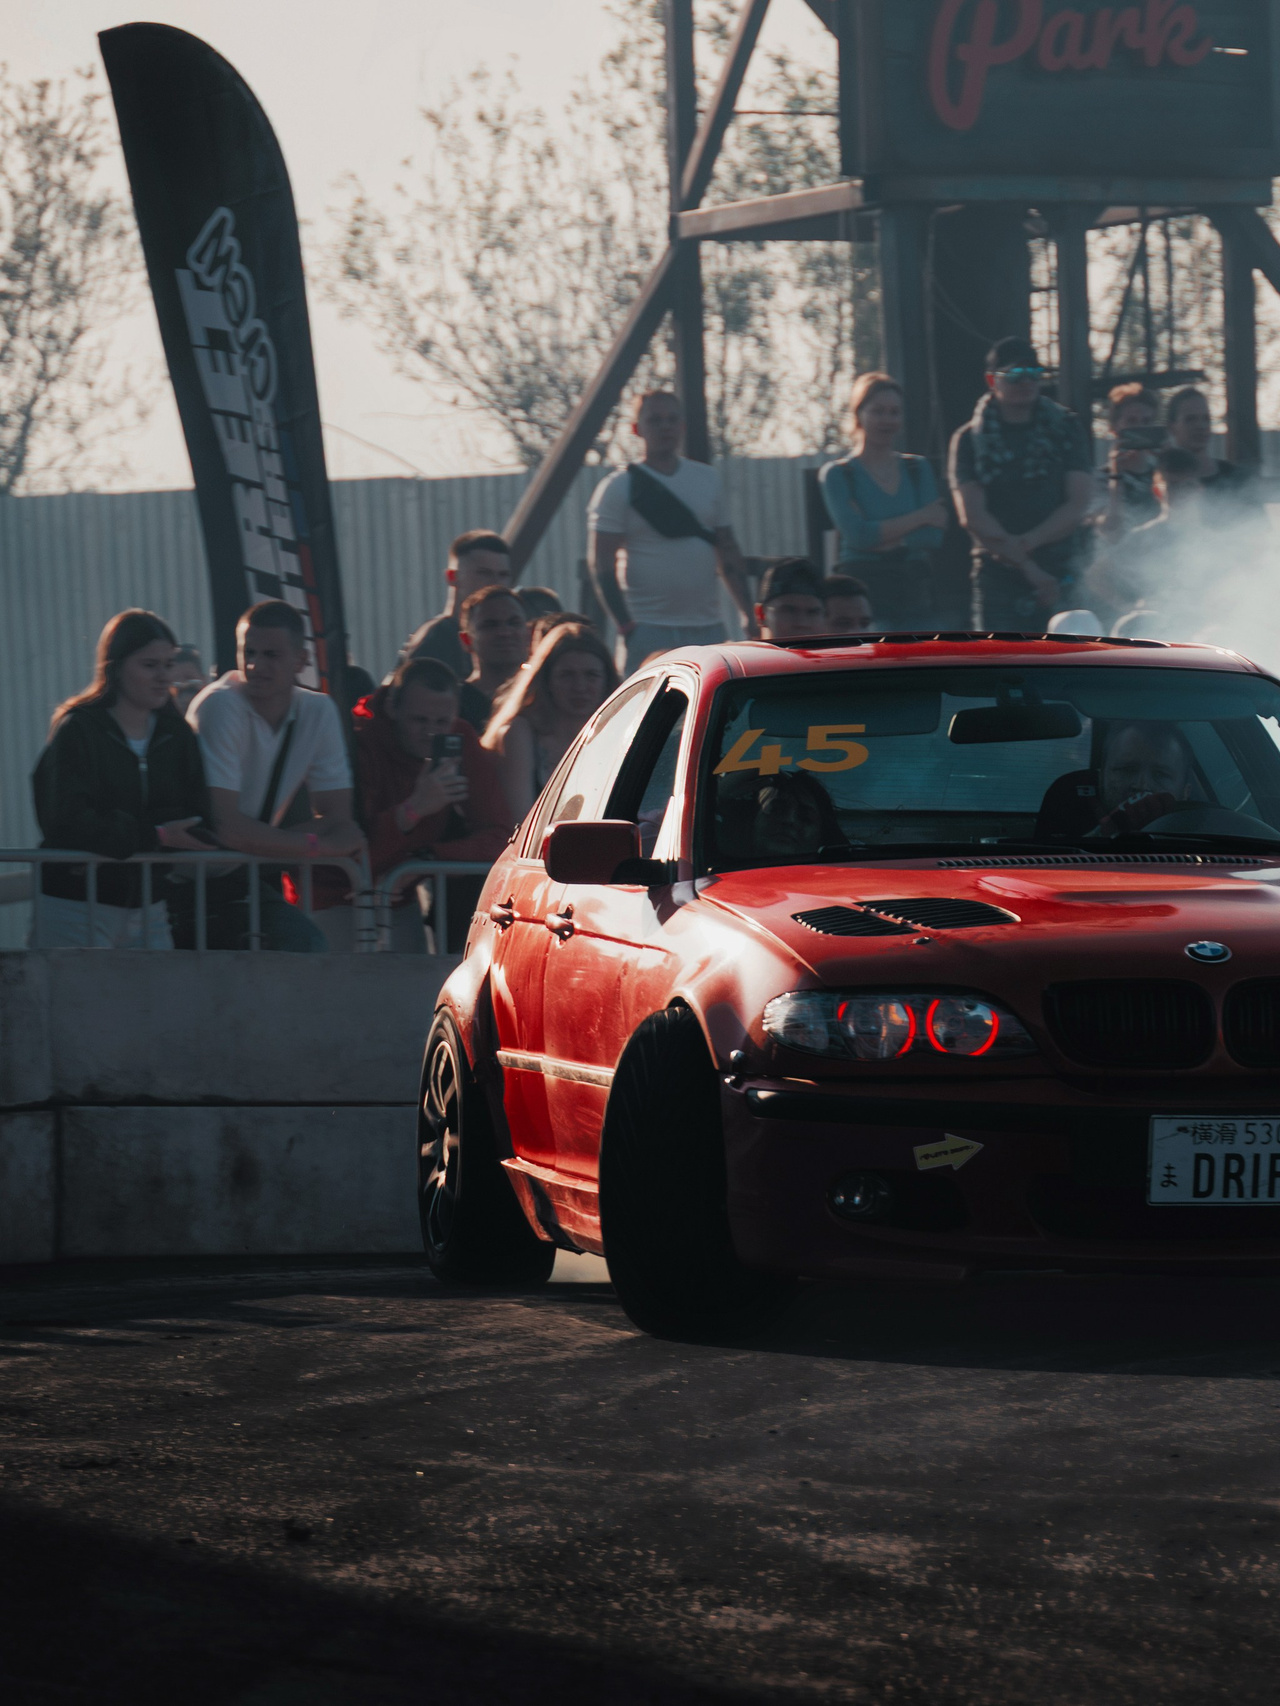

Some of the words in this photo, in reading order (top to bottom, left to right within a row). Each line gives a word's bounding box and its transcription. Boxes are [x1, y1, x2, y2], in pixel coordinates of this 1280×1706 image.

[928, 0, 1212, 131] Park
[175, 268, 286, 602] REET
[712, 724, 869, 776] 45
